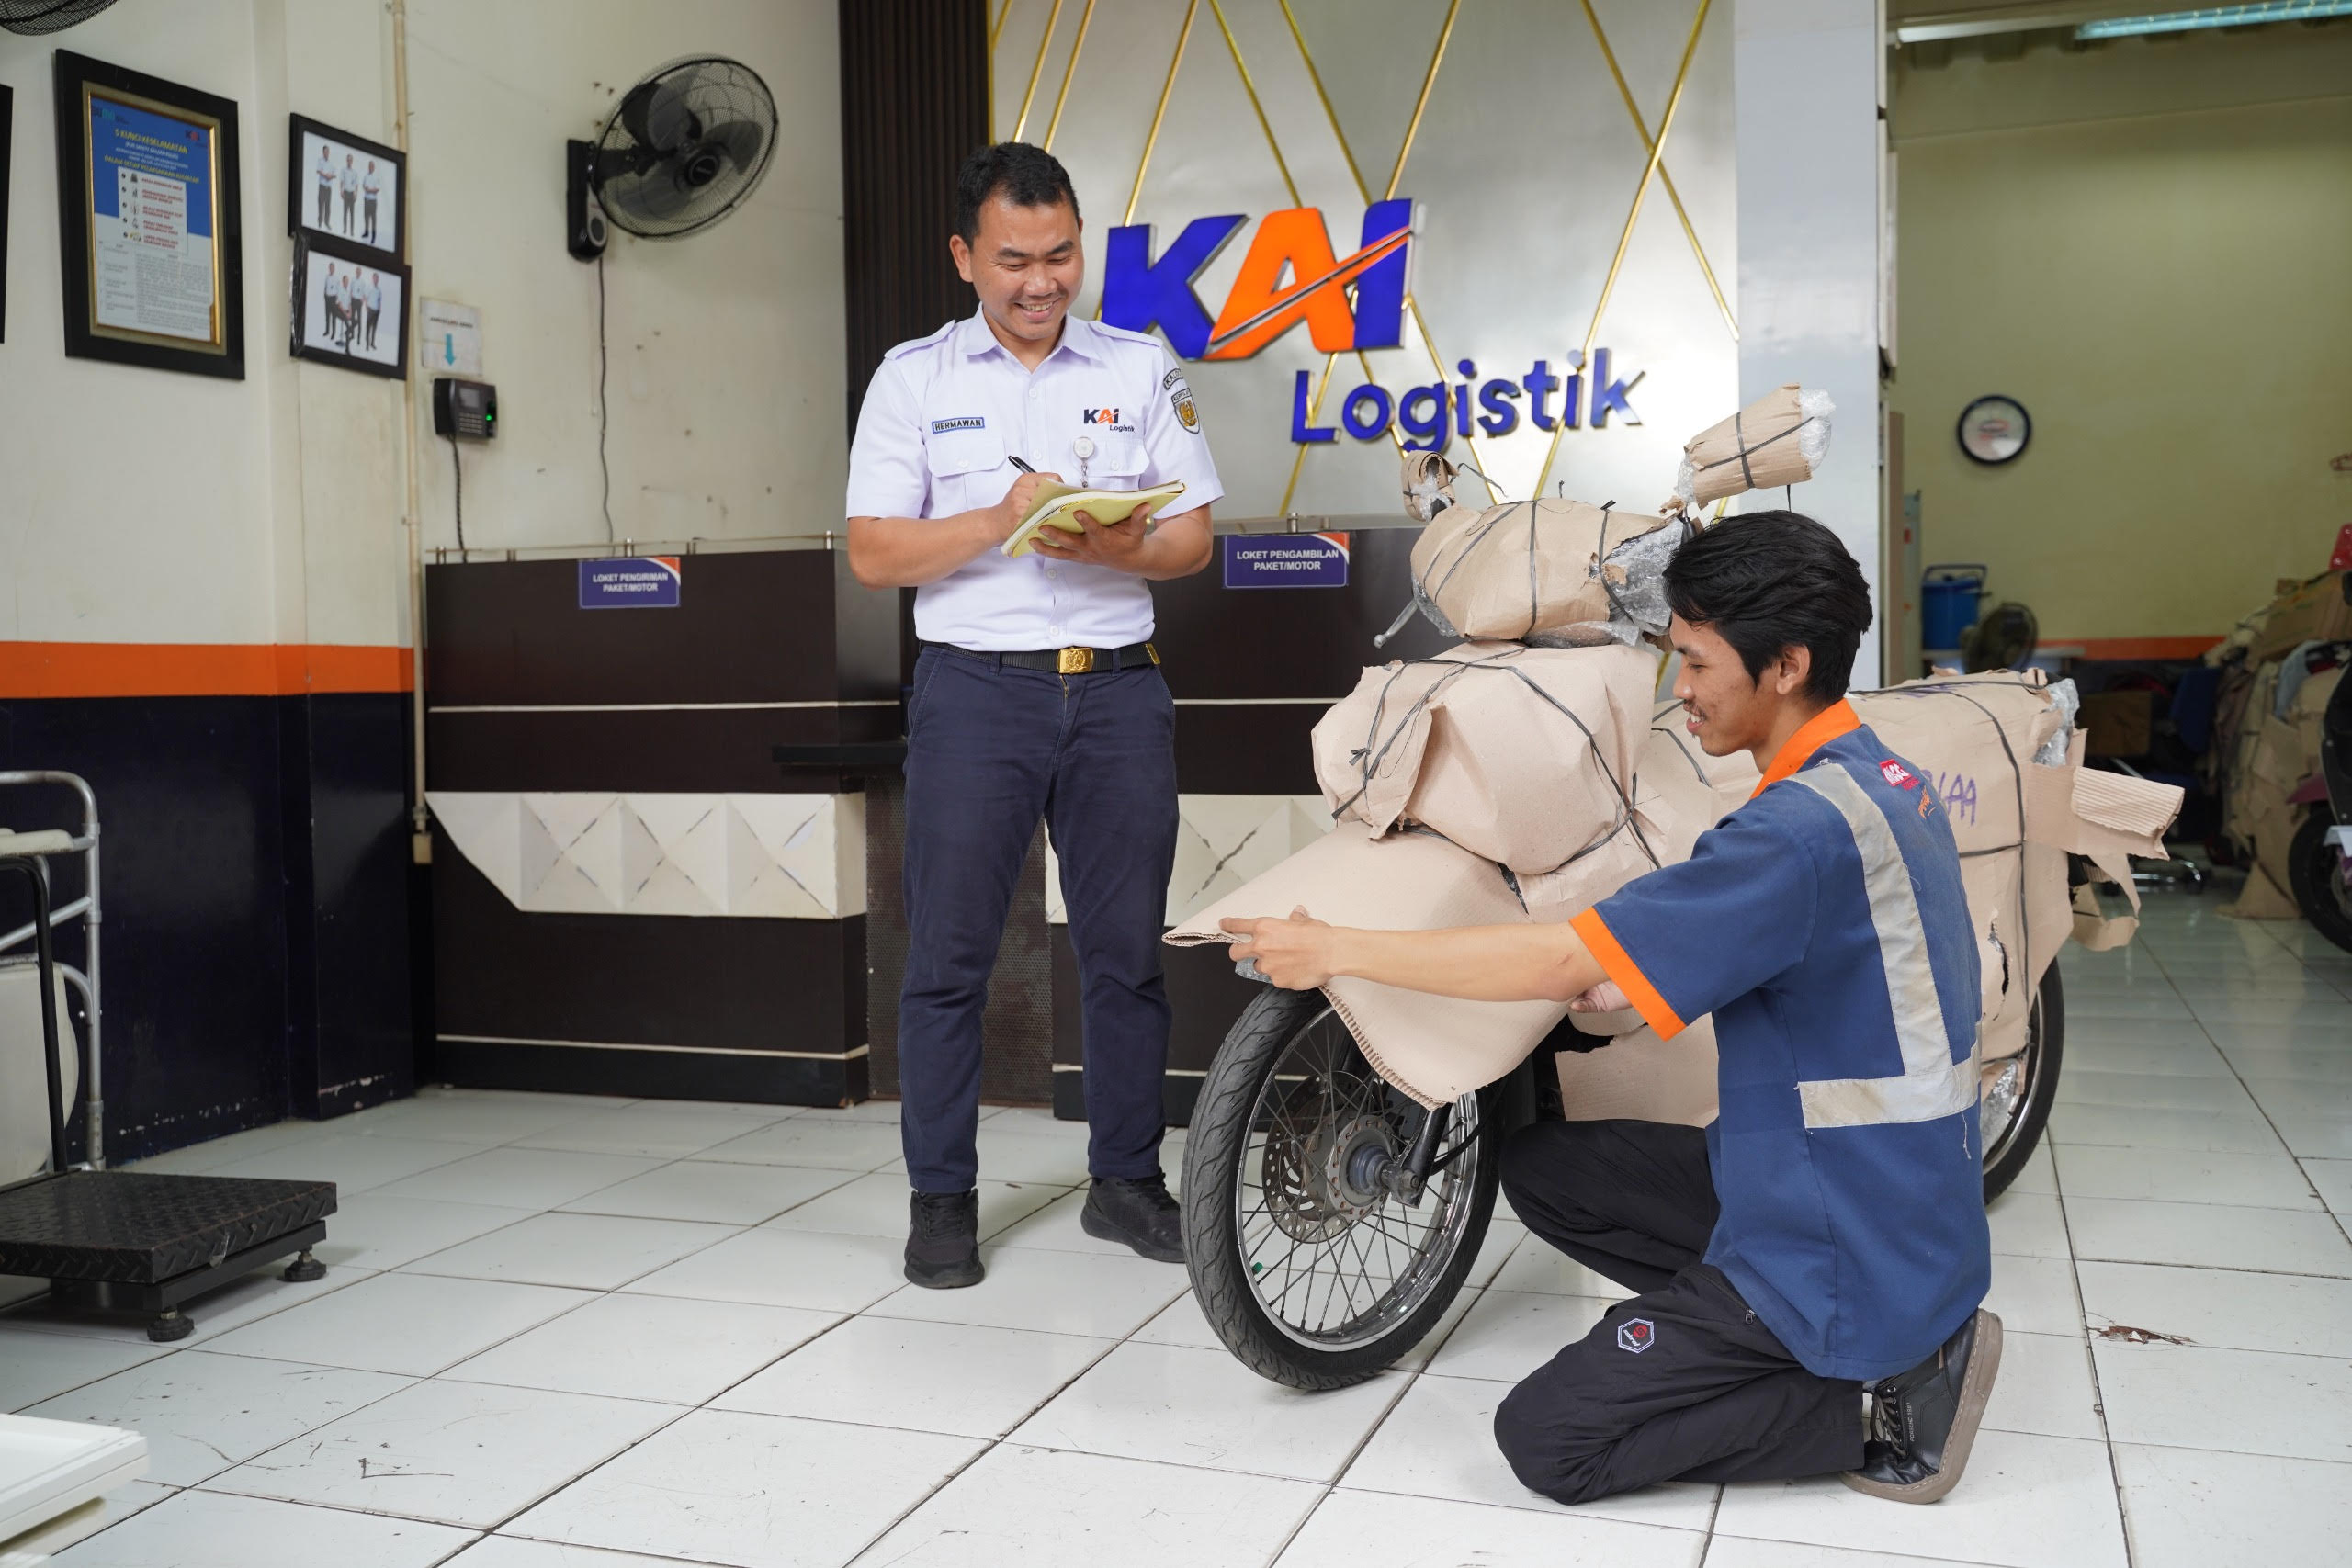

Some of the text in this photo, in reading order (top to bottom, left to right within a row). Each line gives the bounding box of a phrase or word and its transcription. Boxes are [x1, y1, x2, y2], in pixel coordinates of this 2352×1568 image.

[1102, 198, 1415, 361] KAI
[1292, 348, 1646, 453] Logistik
[1084, 408, 1119, 424] KAI
[934, 419, 981, 431] HERMAWAN
[1110, 424, 1135, 433] Logistik
[1237, 549, 1339, 559] LOKET PENGAMBILAN
[1254, 561, 1321, 570] PAKET/MOTOR
[593, 571, 669, 583] LOKET PENGIRIMAN
[603, 582, 659, 593] PAKET/MOTOR
